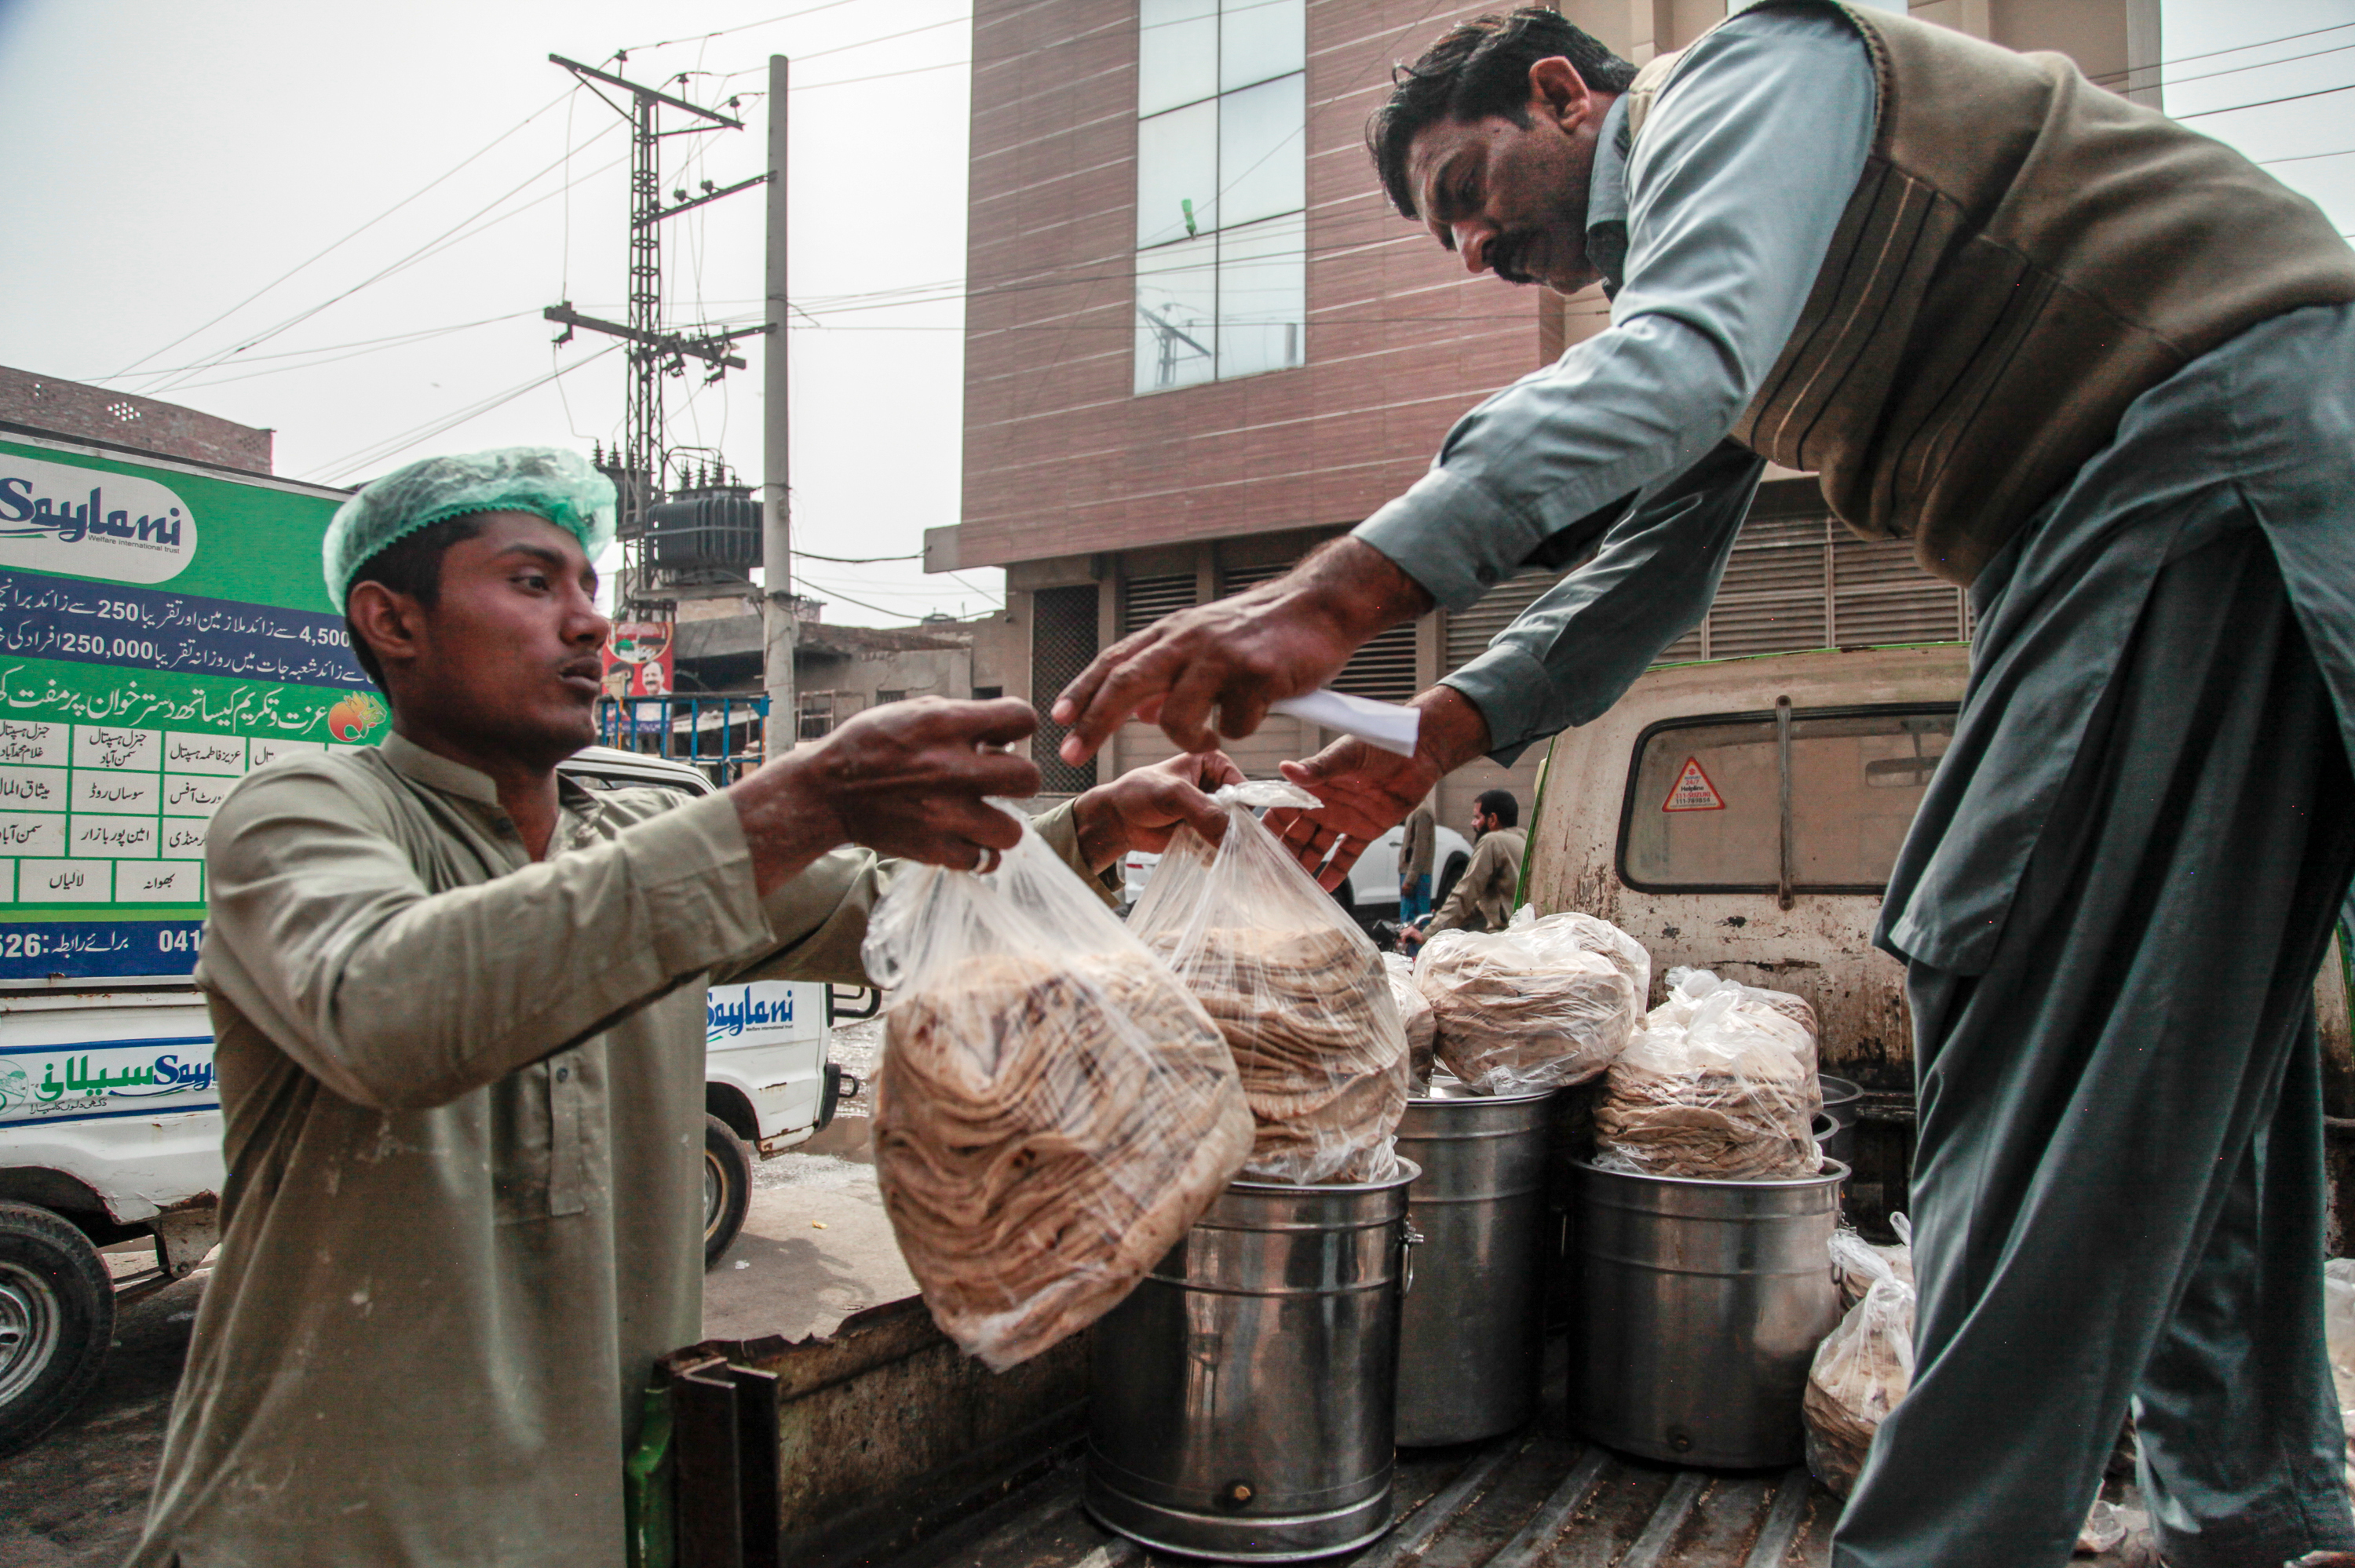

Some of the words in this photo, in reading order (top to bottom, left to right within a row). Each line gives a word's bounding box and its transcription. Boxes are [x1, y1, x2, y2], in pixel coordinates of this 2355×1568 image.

[0, 478, 181, 546] Saylani
[88, 534, 117, 545] Welfare
[119, 539, 163, 552] international
[34, 589, 69, 611] زائد
[68, 602, 97, 614] سے
[97, 600, 139, 622] 250
[176, 612, 197, 626] اور
[198, 611, 246, 633] ملازمین
[246, 616, 274, 636] زائد
[7, 619, 32, 651] کی
[24, 625, 61, 653] افراد
[273, 627, 298, 639] سے
[299, 625, 350, 647] 4,500
[62, 633, 153, 660] 250,000
[188, 649, 231, 669] روزانہ
[232, 651, 256, 673] میں
[316, 660, 343, 680] زائد
[9, 679, 71, 708] مفت
[57, 692, 86, 717] پر
[278, 706, 328, 735] عزت
[26, 722, 50, 741] جنرل
[89, 727, 123, 749] ہسپتال
[122, 730, 147, 749] جنرل
[100, 749, 118, 768] آباد
[114, 750, 137, 767] سمن
[170, 742, 201, 763] ہسپتال
[199, 746, 221, 760] فاطمہ
[221, 750, 242, 764] عزیز
[20, 780, 50, 800] میثاق
[89, 782, 108, 799] روڈ
[108, 786, 144, 801] سوساں
[170, 782, 198, 804] آفس
[16, 824, 43, 844] سمن
[80, 828, 108, 844] بازار
[127, 828, 150, 844] امین
[170, 830, 199, 848] منڈی
[49, 871, 85, 890] لالیاں
[143, 873, 176, 890] بھوانہ
[85, 931, 129, 953] برائے
[35, 1055, 154, 1102] سیلانی
